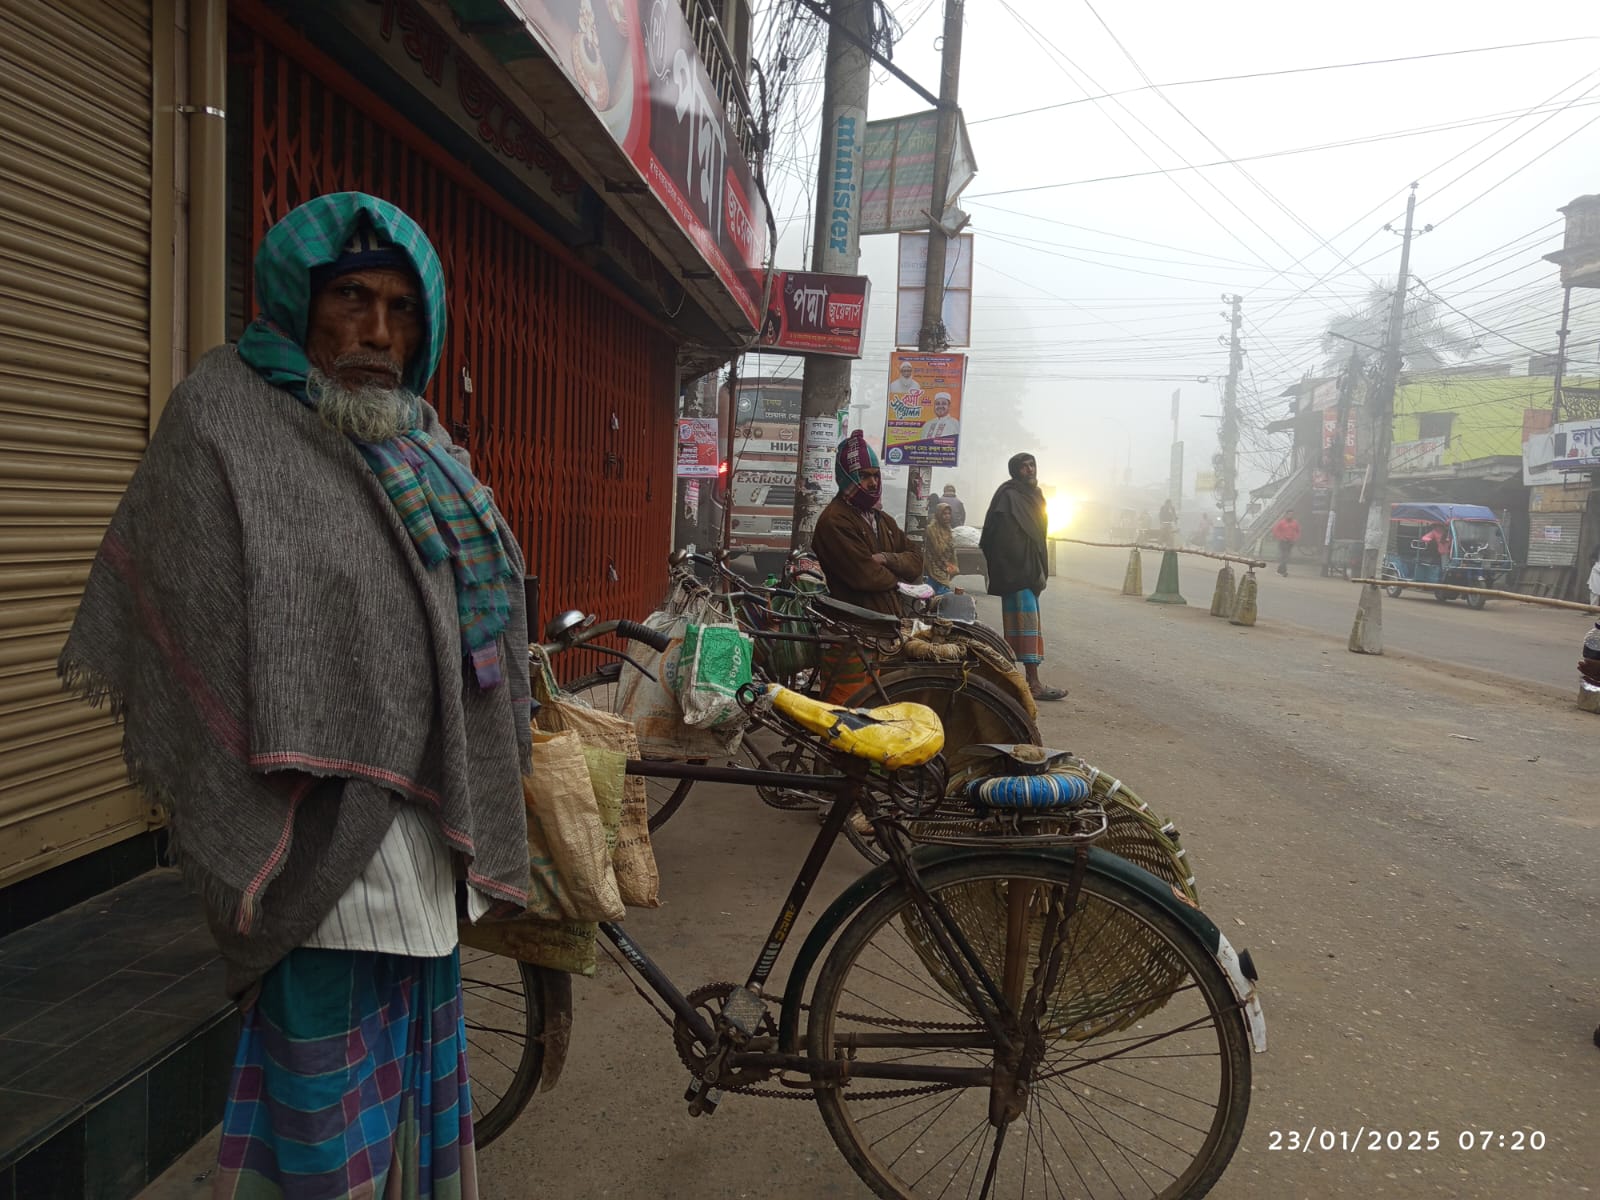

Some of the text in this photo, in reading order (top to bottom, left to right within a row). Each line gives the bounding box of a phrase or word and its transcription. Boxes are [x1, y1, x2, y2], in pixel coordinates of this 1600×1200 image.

[673, 48, 728, 247] পদ্মা
[829, 115, 861, 255] minister
[793, 283, 863, 328] পদ্মা জুয়েলার্স
